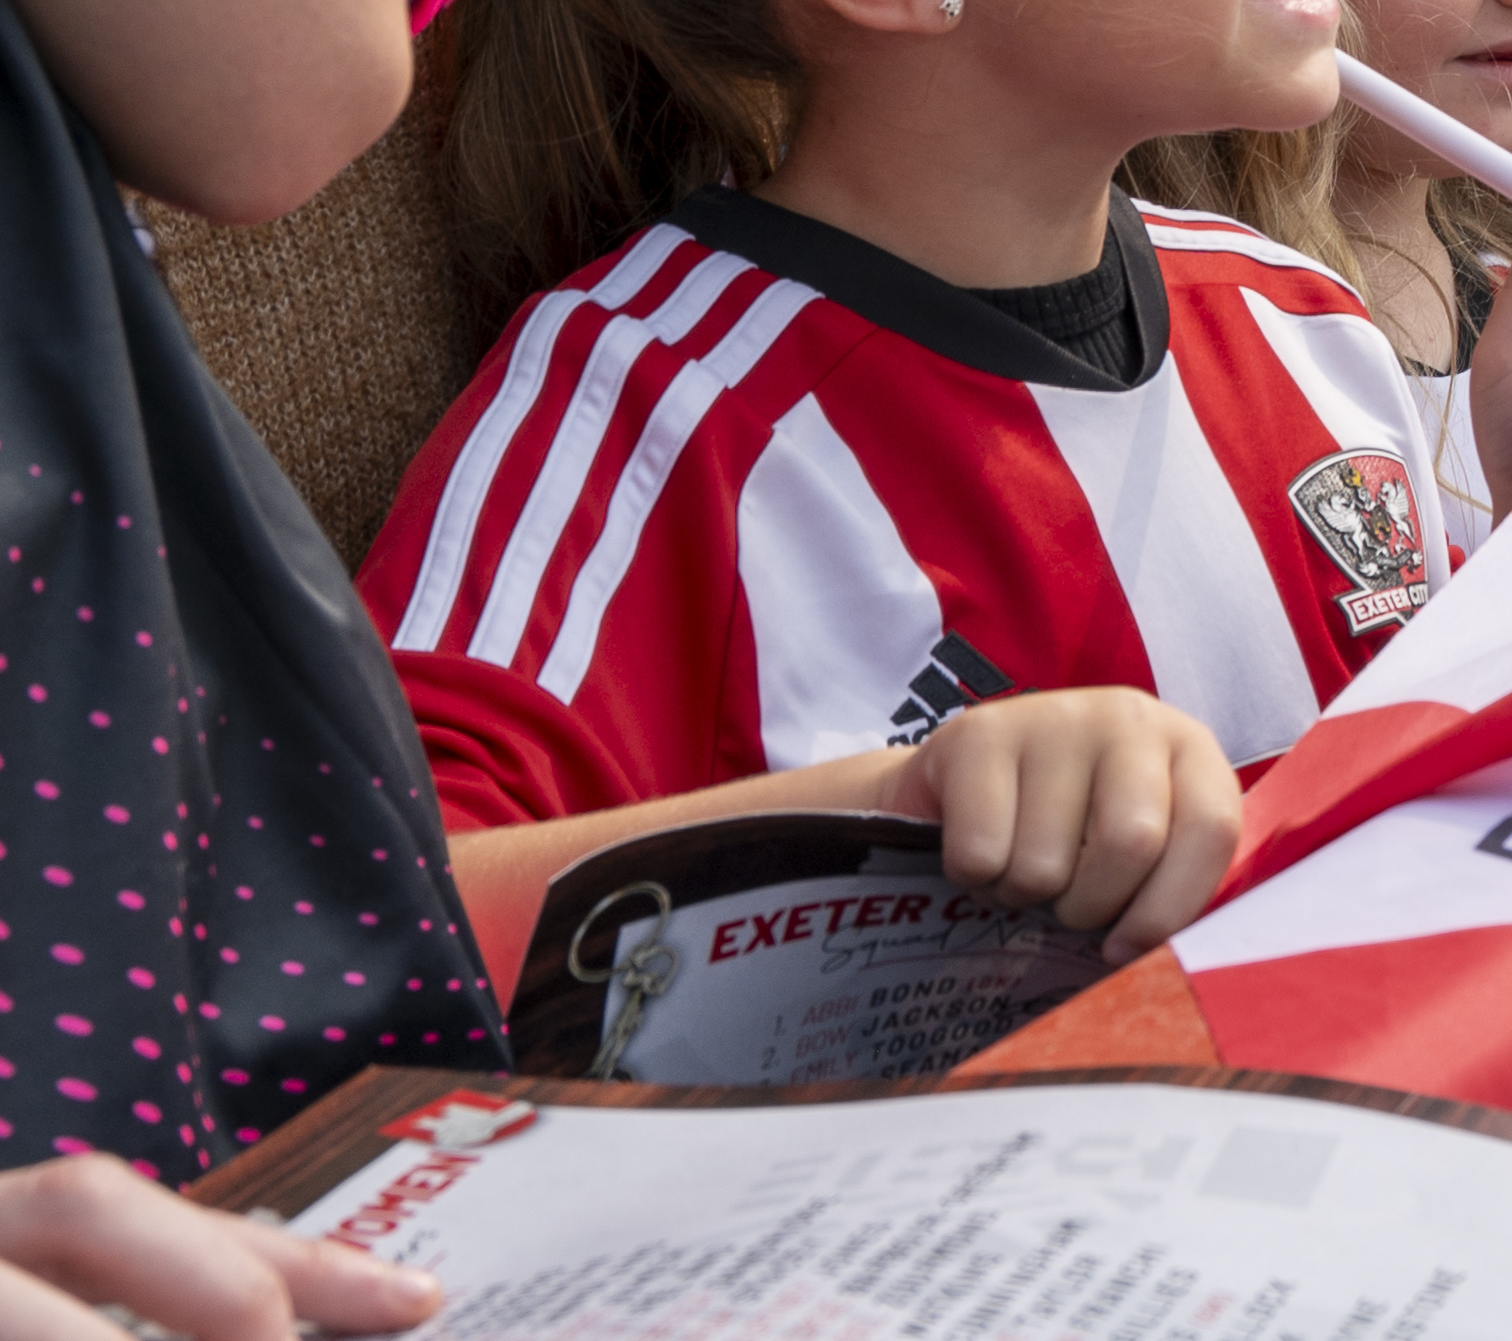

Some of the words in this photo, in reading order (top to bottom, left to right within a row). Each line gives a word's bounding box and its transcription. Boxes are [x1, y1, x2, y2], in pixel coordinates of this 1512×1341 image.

[1351, 586, 1411, 622] EXETER
[706, 893, 934, 966] EXETER
[868, 976, 958, 1009] BOND
[794, 1025, 848, 1060] BOW
[860, 994, 1013, 1039] JACKSON
[871, 1015, 1014, 1062] TOOGOOD
